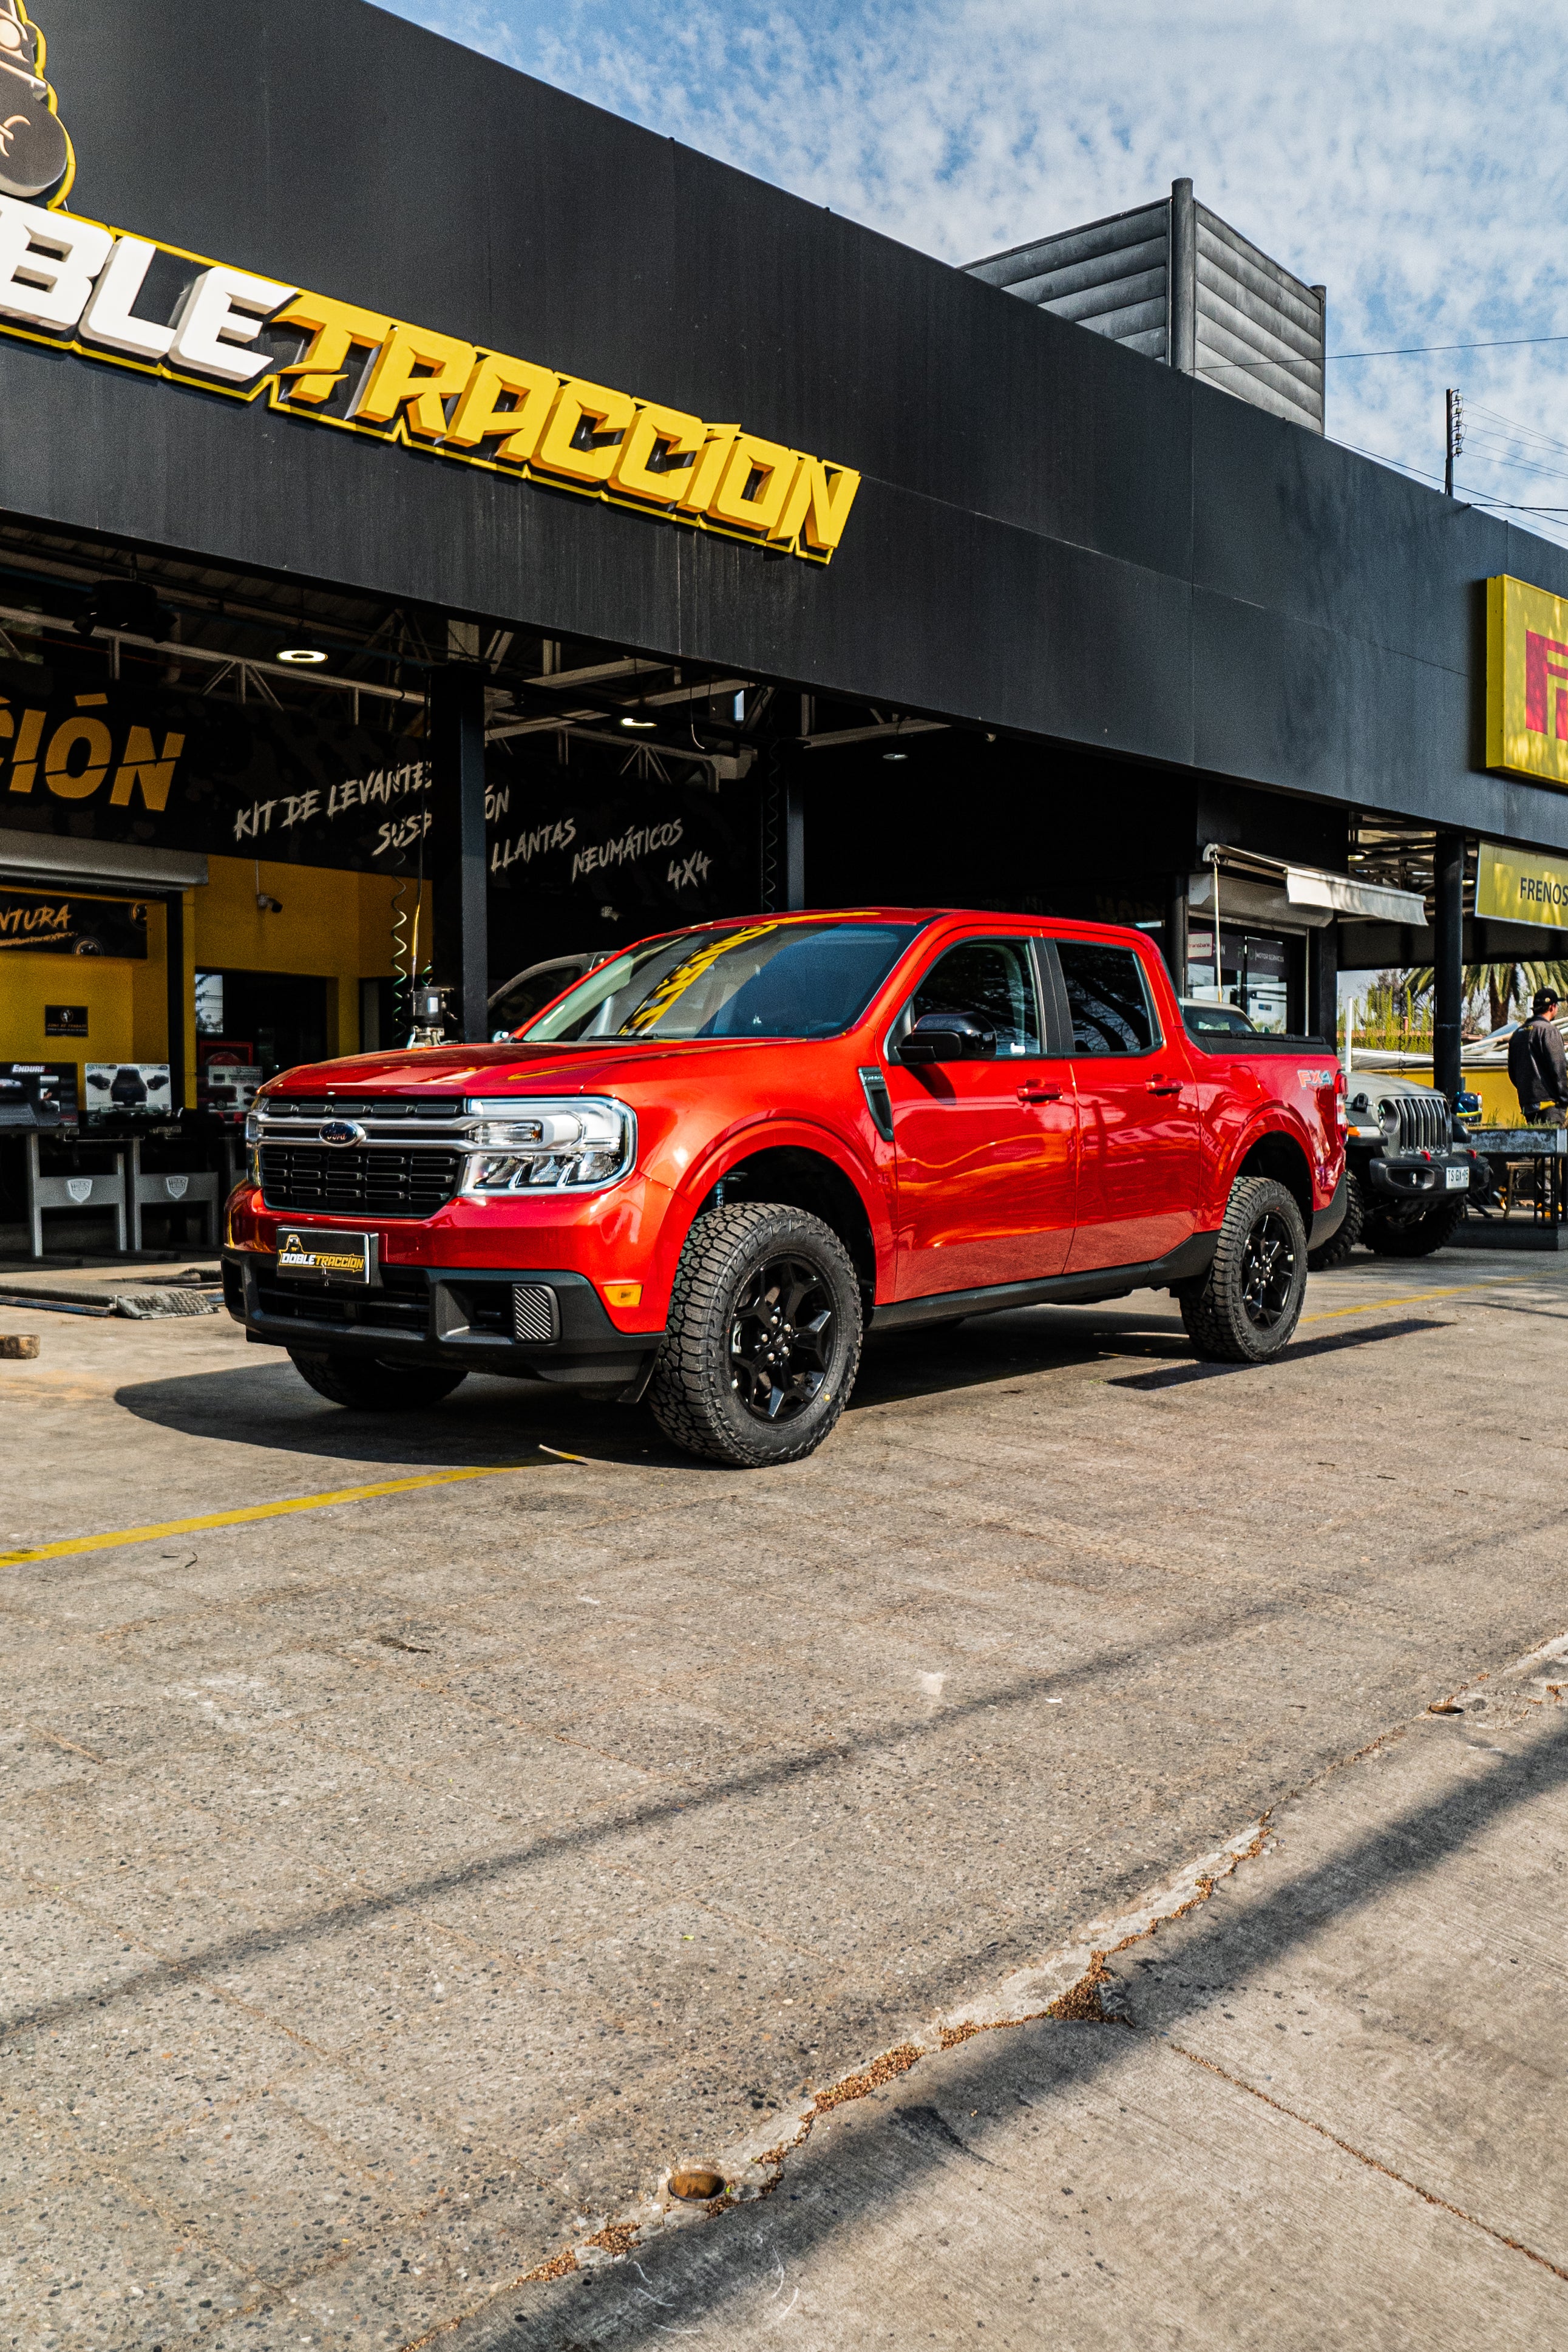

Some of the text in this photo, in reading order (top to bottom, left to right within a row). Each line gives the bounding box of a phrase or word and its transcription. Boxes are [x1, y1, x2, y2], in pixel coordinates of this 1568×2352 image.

[233, 800, 278, 842] KIT
[279, 788, 322, 831] DE
[490, 817, 577, 875] LLANTAS
[572, 817, 684, 884] NEUMÁTICOS
[1297, 1069, 1334, 1090] FX4
